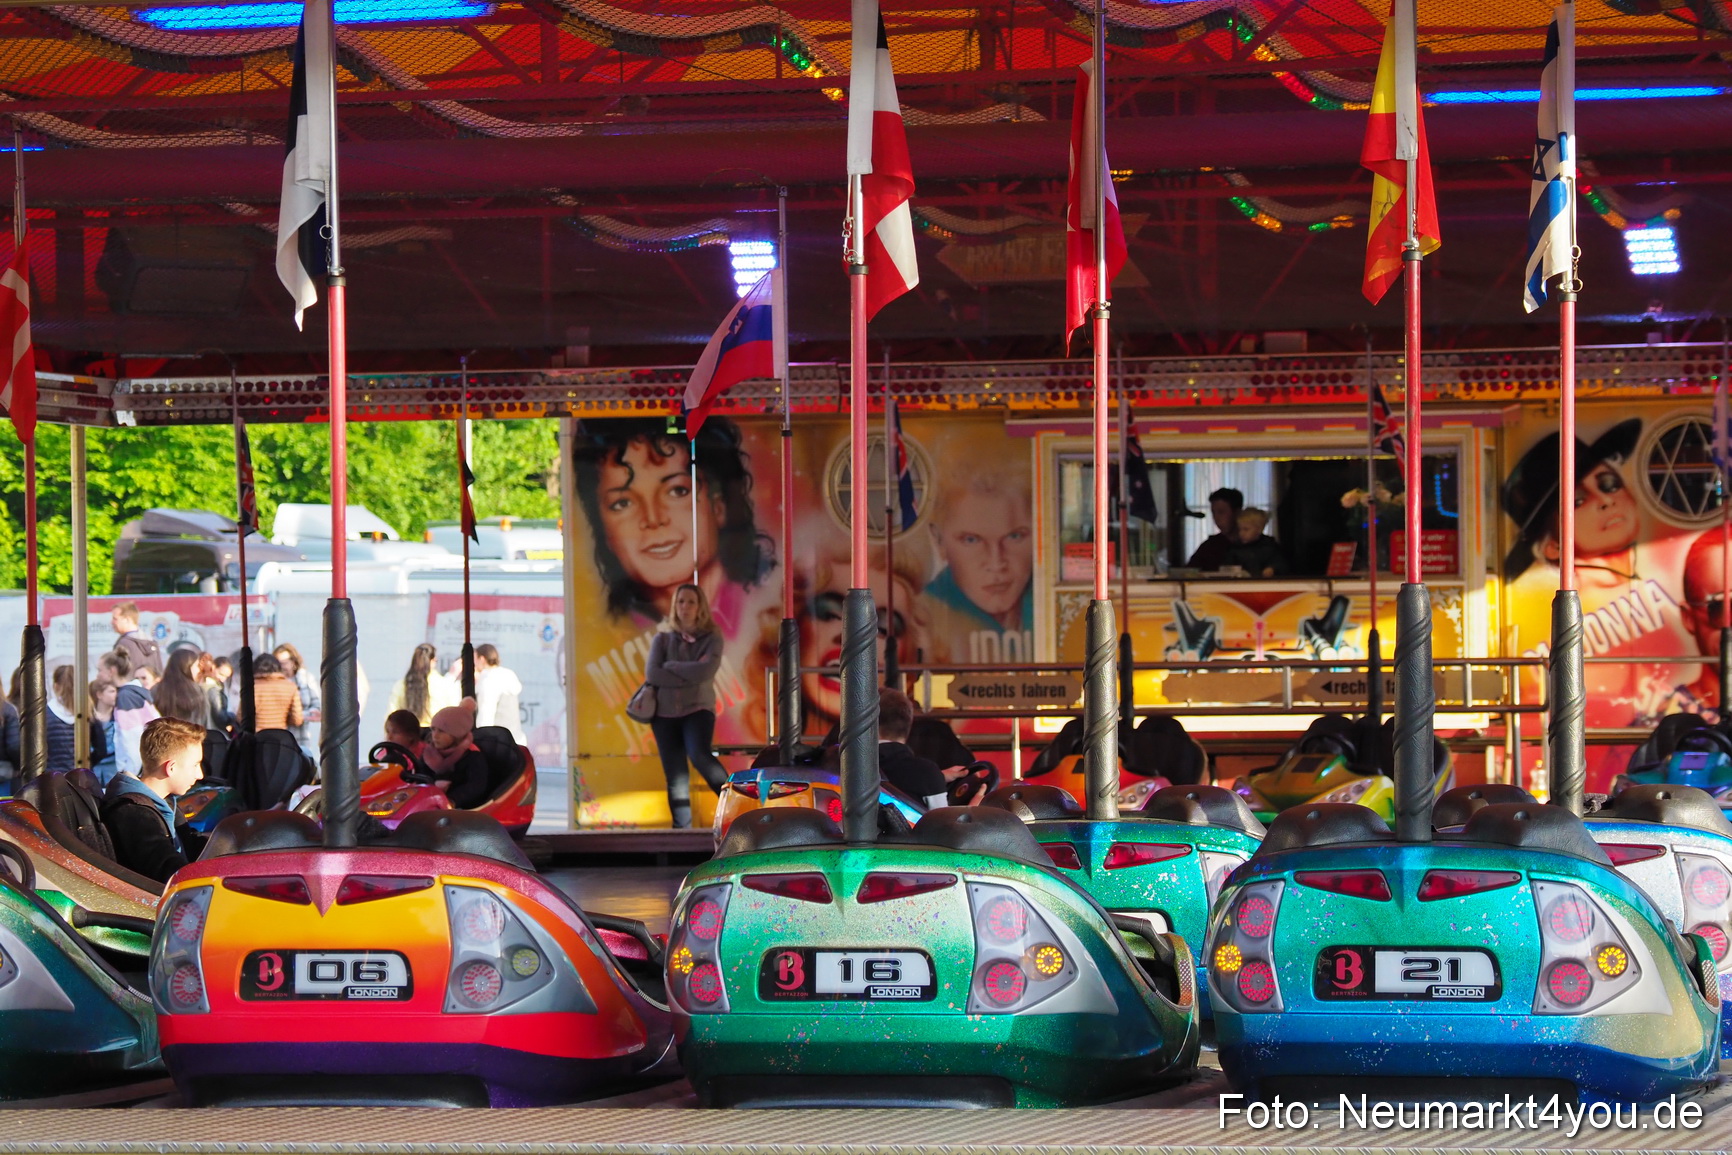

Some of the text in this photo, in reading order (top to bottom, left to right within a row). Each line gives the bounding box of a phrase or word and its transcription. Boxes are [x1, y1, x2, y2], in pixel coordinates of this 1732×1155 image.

[971, 682, 1066, 698] rechts fahren
[1334, 680, 1372, 695] rech
[306, 958, 389, 984] 06
[837, 957, 903, 984] 16
[1401, 956, 1462, 983] 21
[348, 987, 399, 999] LONDON
[870, 986, 922, 999] LONDON
[1431, 986, 1486, 999] LONDON
